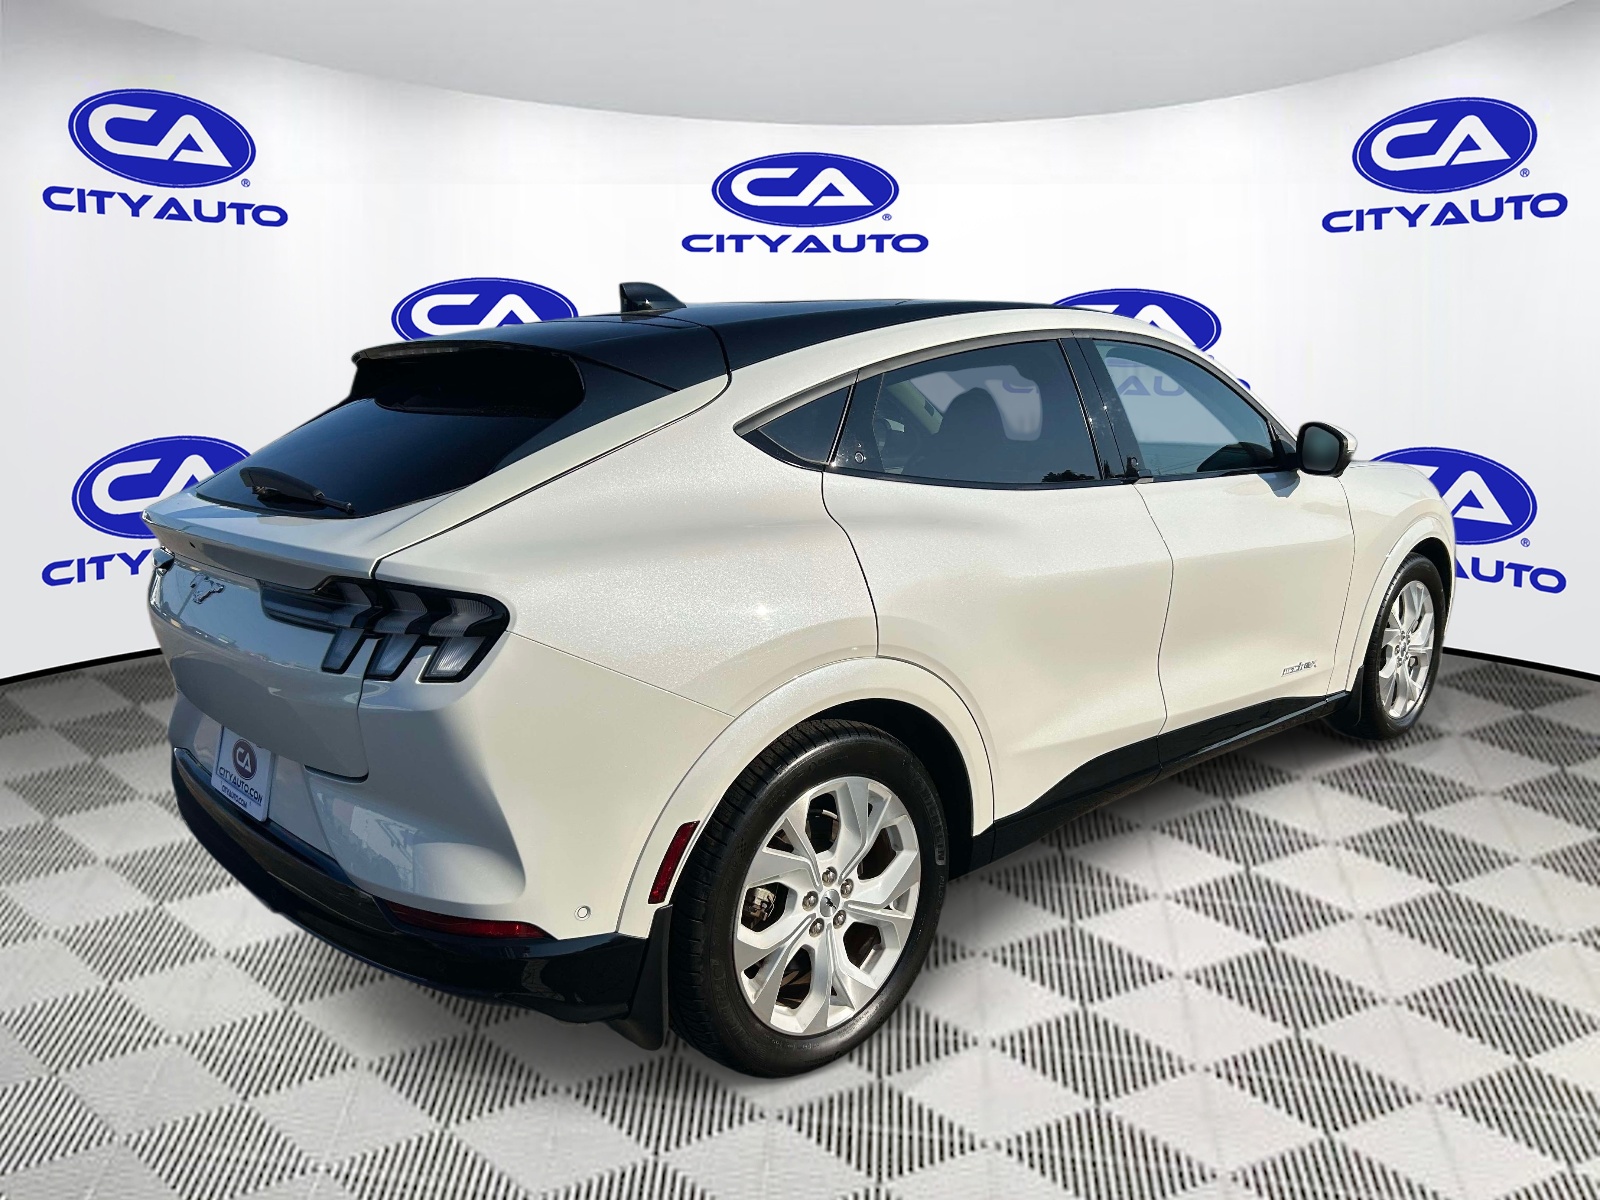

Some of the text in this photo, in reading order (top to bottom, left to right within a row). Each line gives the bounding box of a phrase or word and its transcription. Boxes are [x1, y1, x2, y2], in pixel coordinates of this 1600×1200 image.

[88, 103, 233, 168] CA
[1371, 115, 1511, 172] CA
[731, 167, 874, 207] CA
